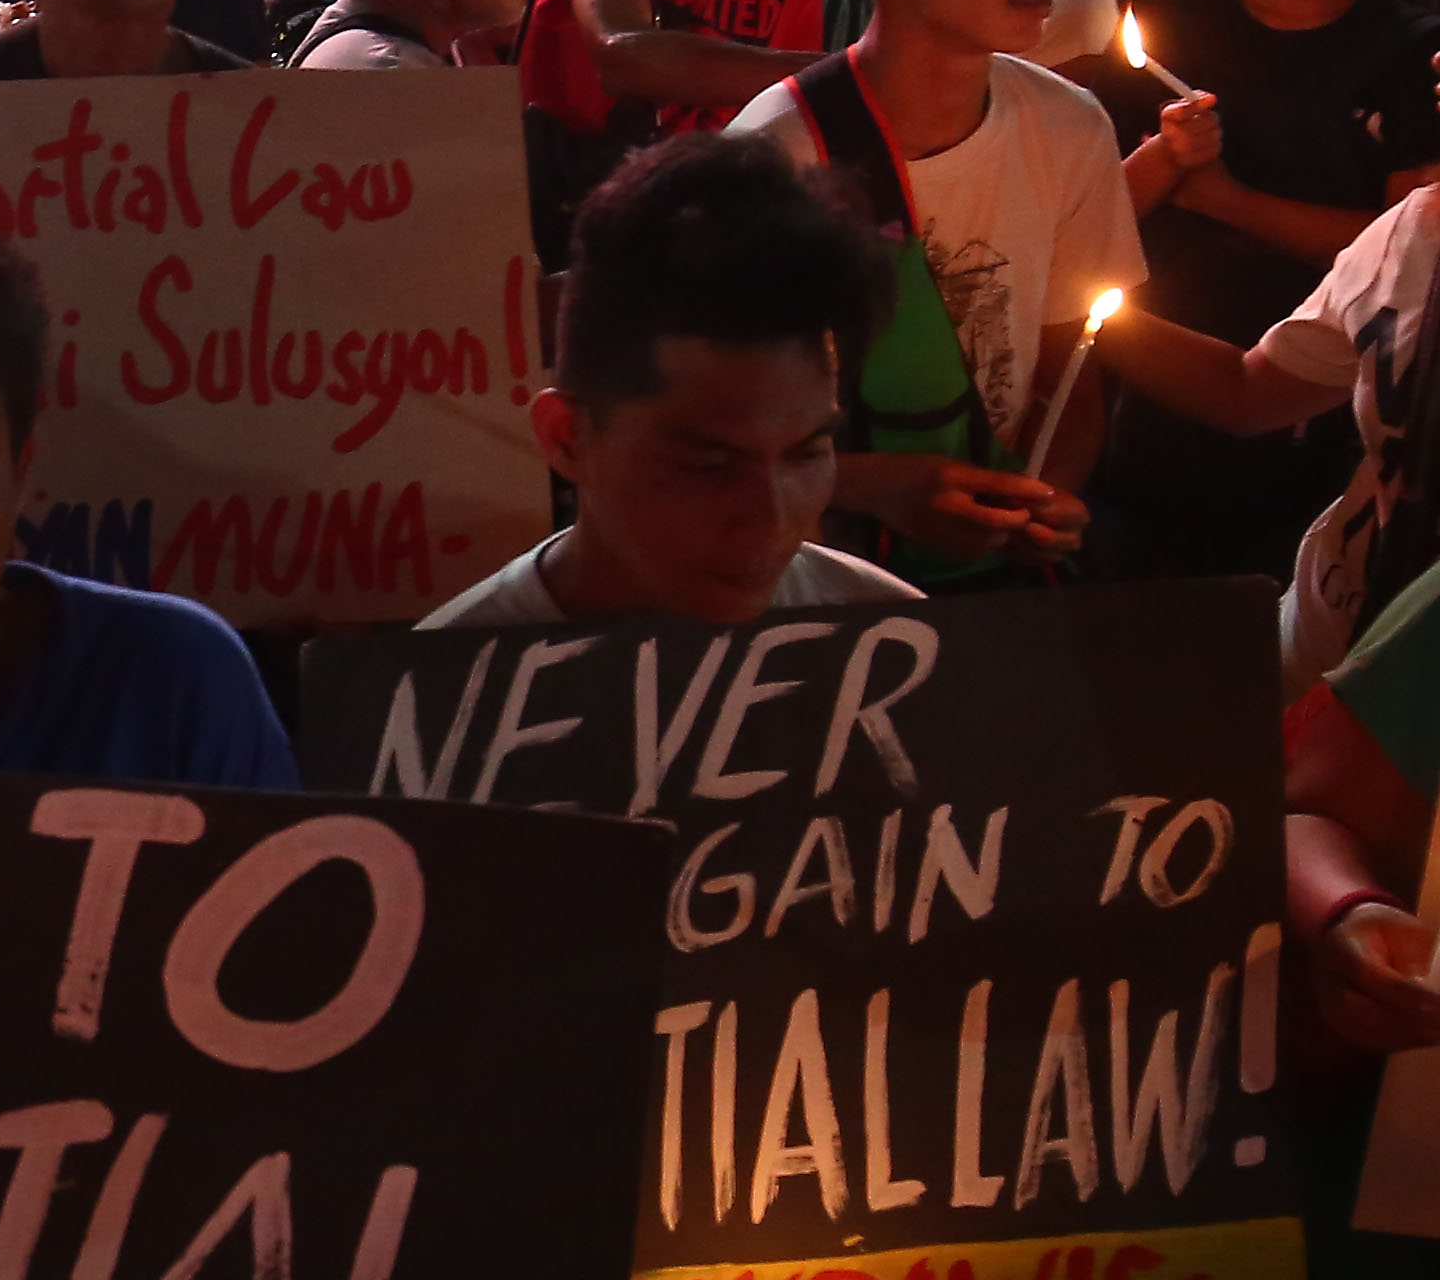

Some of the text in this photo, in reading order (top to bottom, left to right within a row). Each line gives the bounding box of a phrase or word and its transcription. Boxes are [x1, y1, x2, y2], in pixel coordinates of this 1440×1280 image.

[230, 95, 414, 231] Law
[122, 253, 531, 454] Sulusyon!
[368, 614, 942, 817] NEVER
[31, 787, 428, 1073] TO
[665, 794, 1234, 954] GAIN TO
[654, 987, 929, 1232] TIAL
